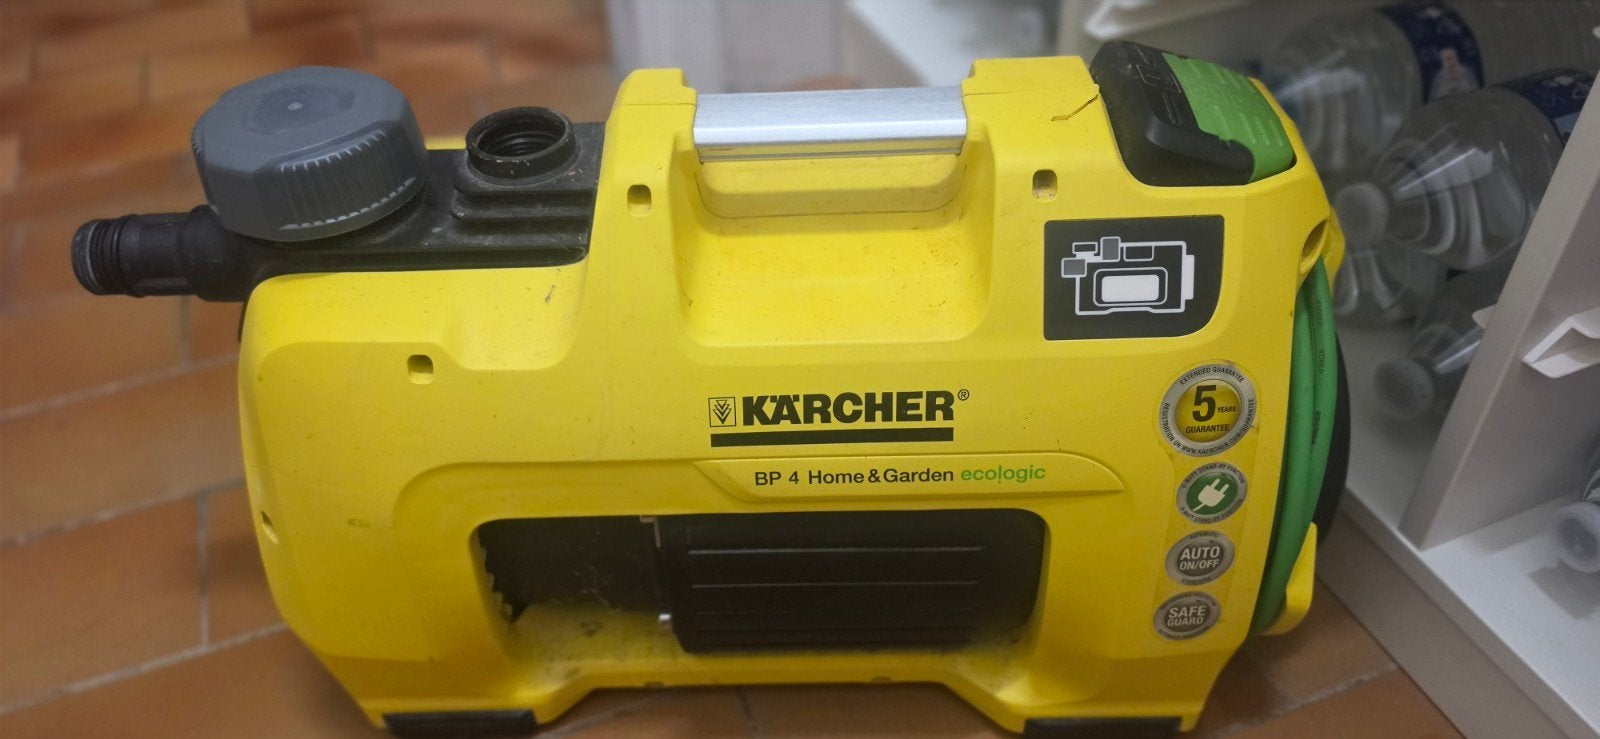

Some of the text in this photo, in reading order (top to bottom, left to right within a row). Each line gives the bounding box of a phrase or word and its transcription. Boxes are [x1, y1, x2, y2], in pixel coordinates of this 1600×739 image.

[1180, 366, 1245, 385] EXTENDED GUARANTEE
[742, 390, 954, 426] KÄRCHER
[1192, 384, 1217, 422] 5
[1217, 405, 1237, 413] YEARS
[1160, 402, 1175, 442] REGISTRATION
[1173, 441, 1182, 449] ON
[1185, 424, 1230, 434] GUARANTEE
[755, 470, 782, 486] BP
[788, 470, 800, 485] 4
[1189, 531, 1219, 539] AUTOMATIC
[1180, 546, 1220, 560] AUTO
[1179, 559, 1220, 571] ON/OFF
[1168, 605, 1207, 619] SAFE
[1167, 616, 1204, 627] GUARD
